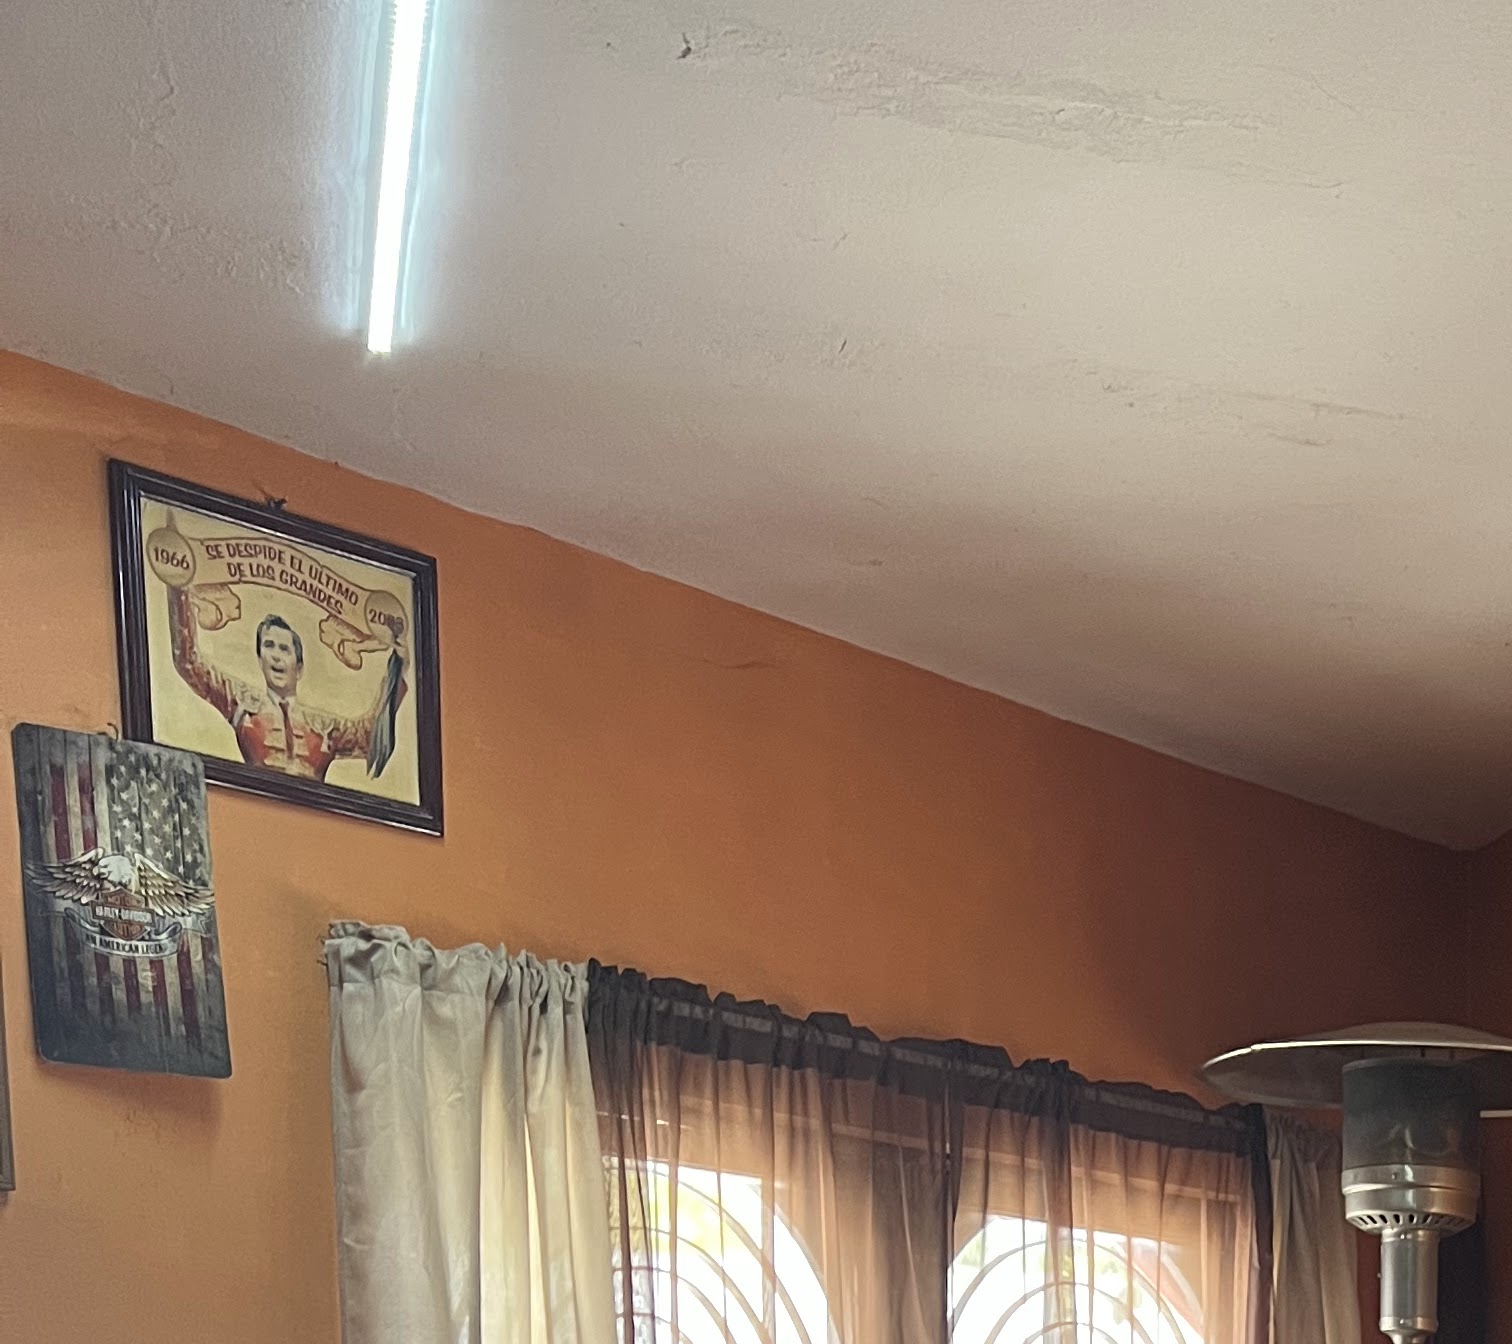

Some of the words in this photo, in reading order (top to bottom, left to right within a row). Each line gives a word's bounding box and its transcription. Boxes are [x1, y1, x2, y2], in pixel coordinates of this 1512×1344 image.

[153, 546, 190, 571] 1966
[206, 544, 225, 560] SE
[226, 542, 286, 566] DESPIDE
[290, 555, 304, 575] EL
[308, 564, 359, 607] ULTIMO
[227, 562, 245, 579] DE
[249, 563, 276, 581] LOS
[280, 570, 345, 616] GRANDES
[100, 937, 139, 954] AMERICAN
